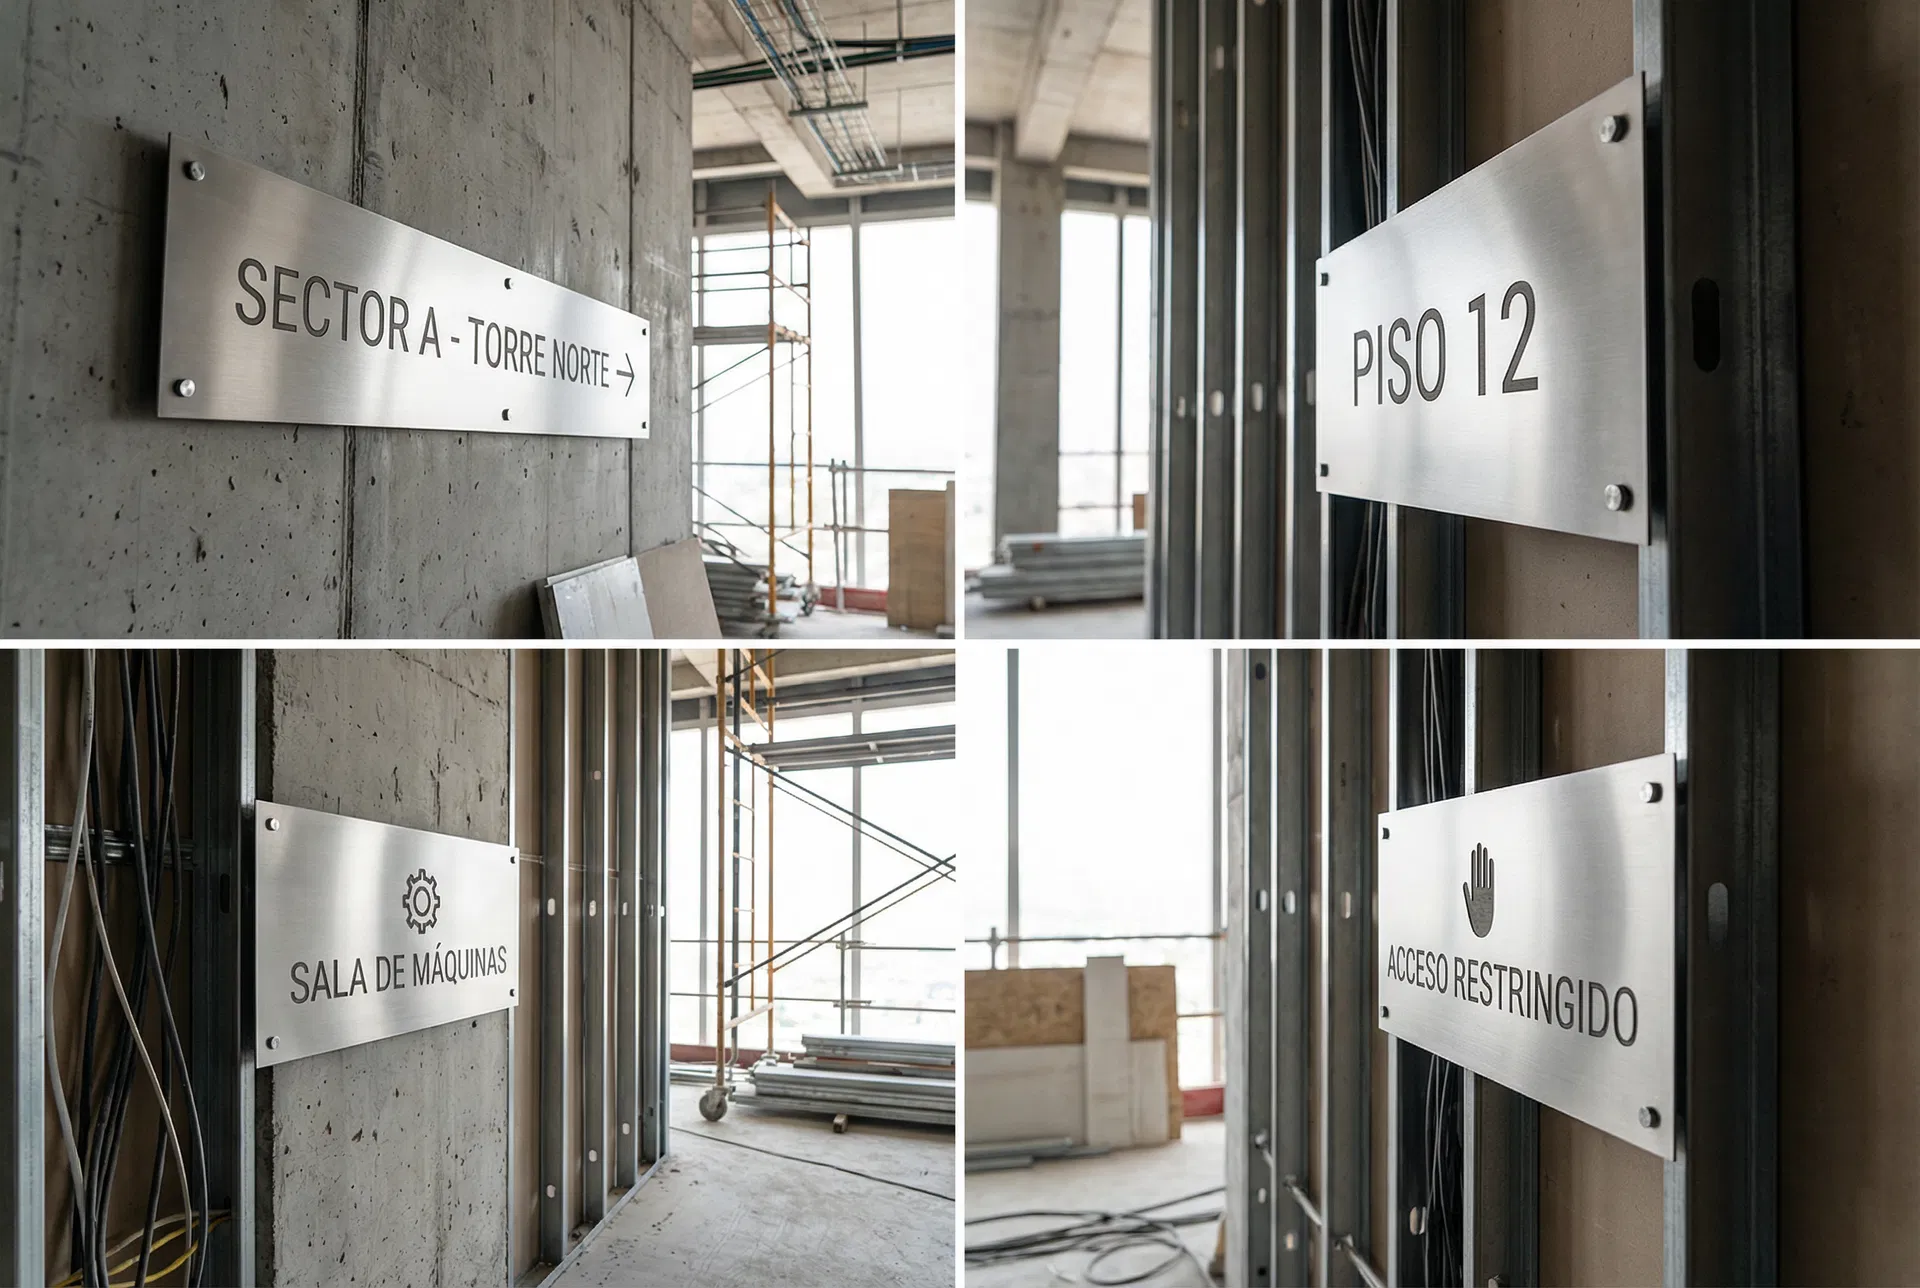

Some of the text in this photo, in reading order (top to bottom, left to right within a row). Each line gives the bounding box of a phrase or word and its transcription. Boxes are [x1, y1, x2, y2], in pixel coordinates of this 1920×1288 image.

[235, 258, 409, 353] SECTOR
[419, 306, 441, 358] A
[468, 316, 546, 377] TORRE
[552, 338, 609, 388] NORTE
[1353, 280, 1538, 407] PISO 12
[290, 942, 507, 1004] SALA DE MÁQUINAS
[1387, 944, 1638, 1047] ACCESO RESTRINGIDO
